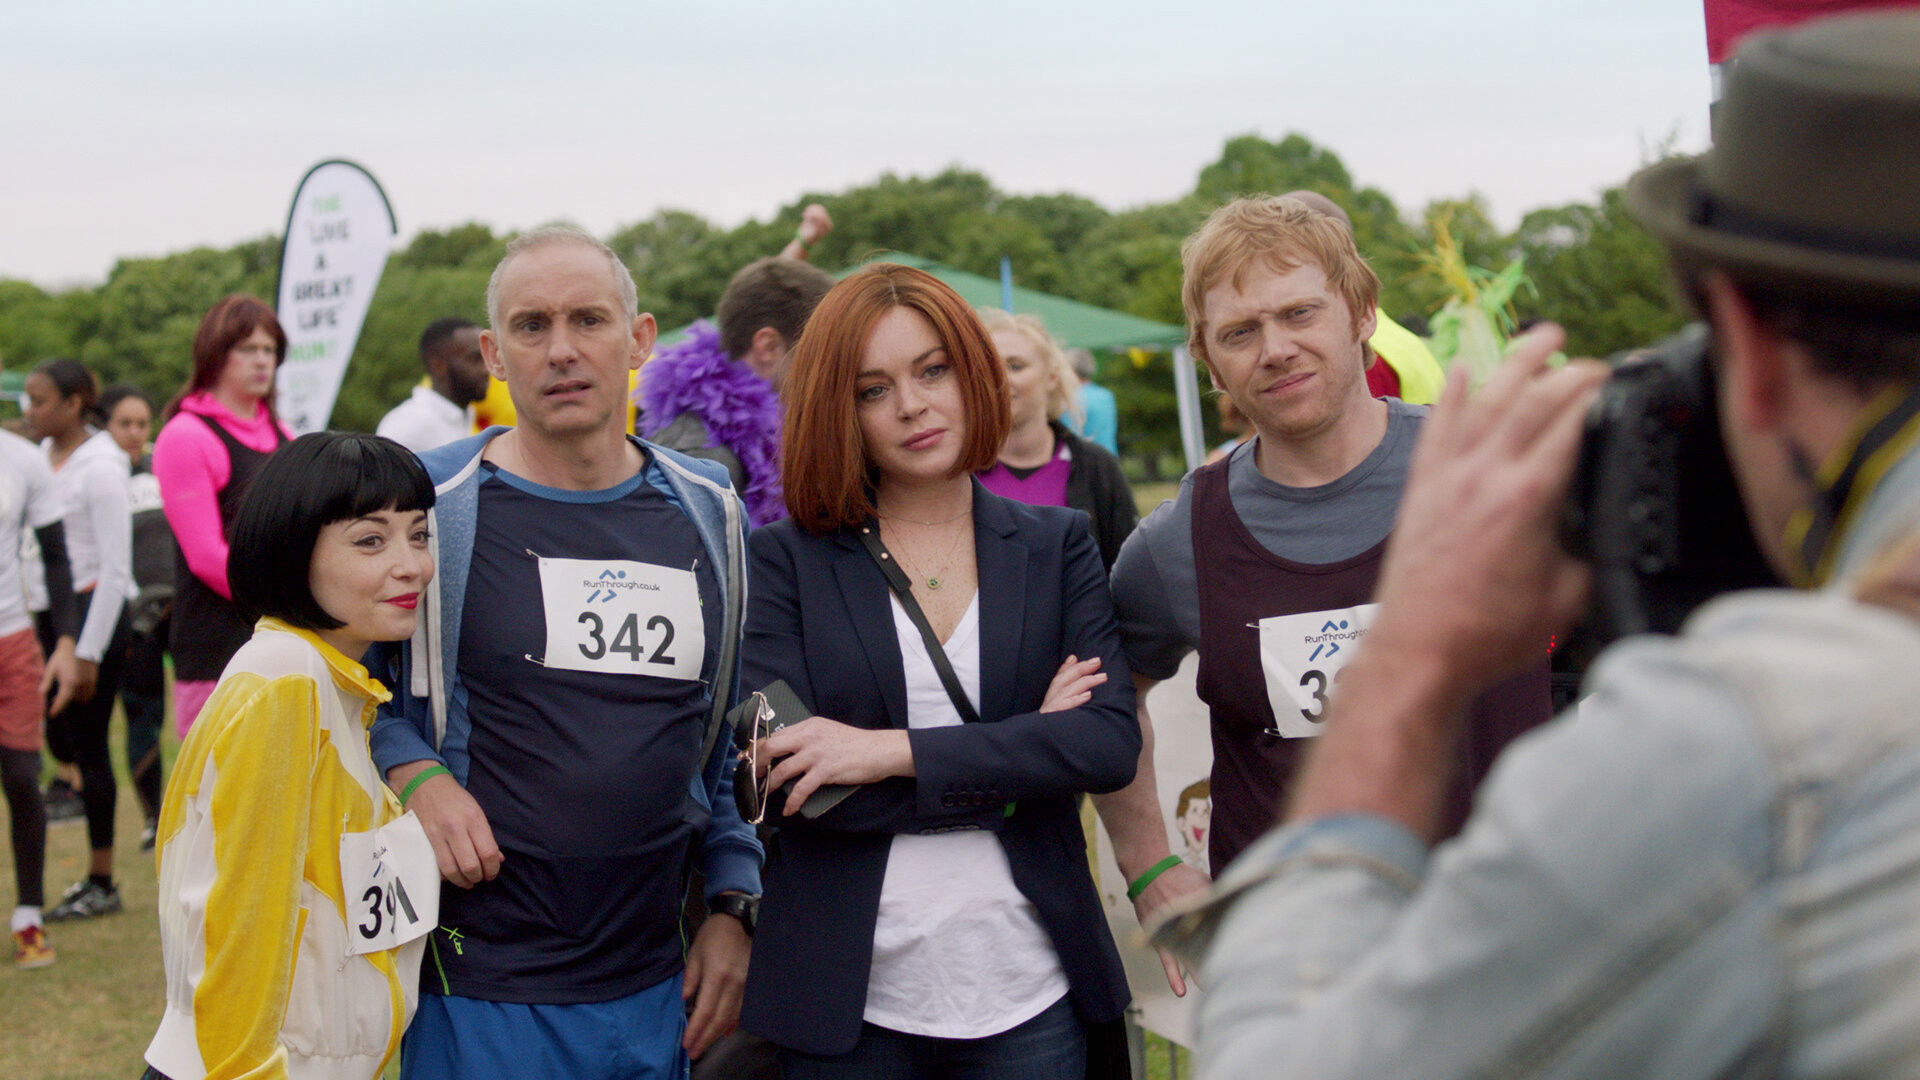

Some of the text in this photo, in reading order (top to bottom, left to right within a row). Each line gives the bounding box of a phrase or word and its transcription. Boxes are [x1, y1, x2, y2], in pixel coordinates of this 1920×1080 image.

[314, 252, 327, 272] A
[293, 277, 354, 303] GREAT
[583, 580, 661, 592] RunThrough.co.uk
[578, 611, 676, 665] 342
